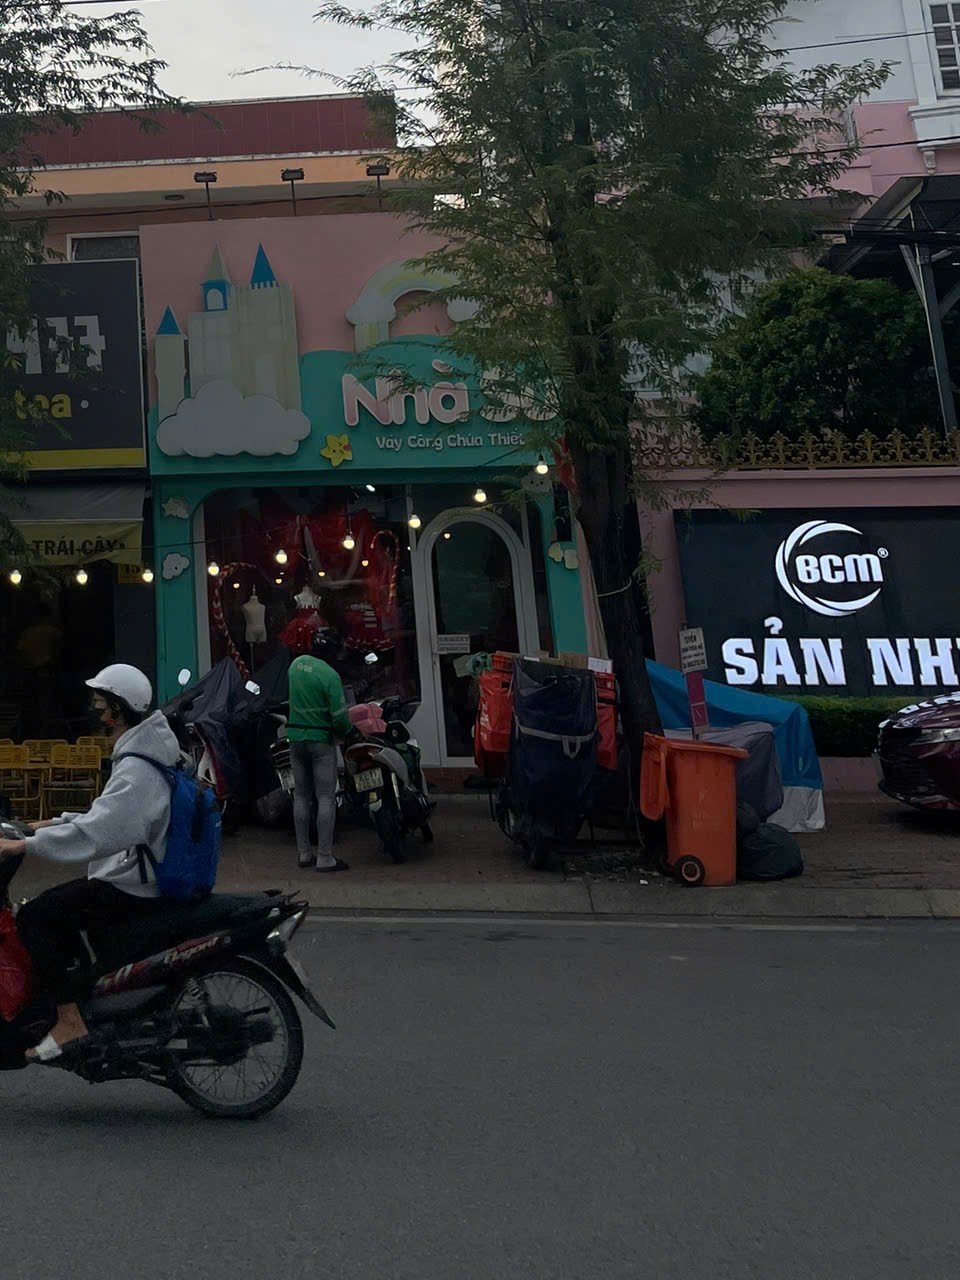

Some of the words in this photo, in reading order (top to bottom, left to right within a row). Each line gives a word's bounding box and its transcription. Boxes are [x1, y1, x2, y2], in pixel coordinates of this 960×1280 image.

[341, 358, 470, 427] Nhà
[407, 433, 444, 452] Công
[447, 432, 484, 448] Chúa
[720, 615, 848, 687] SẢN
[865, 636, 960, 687] NH
